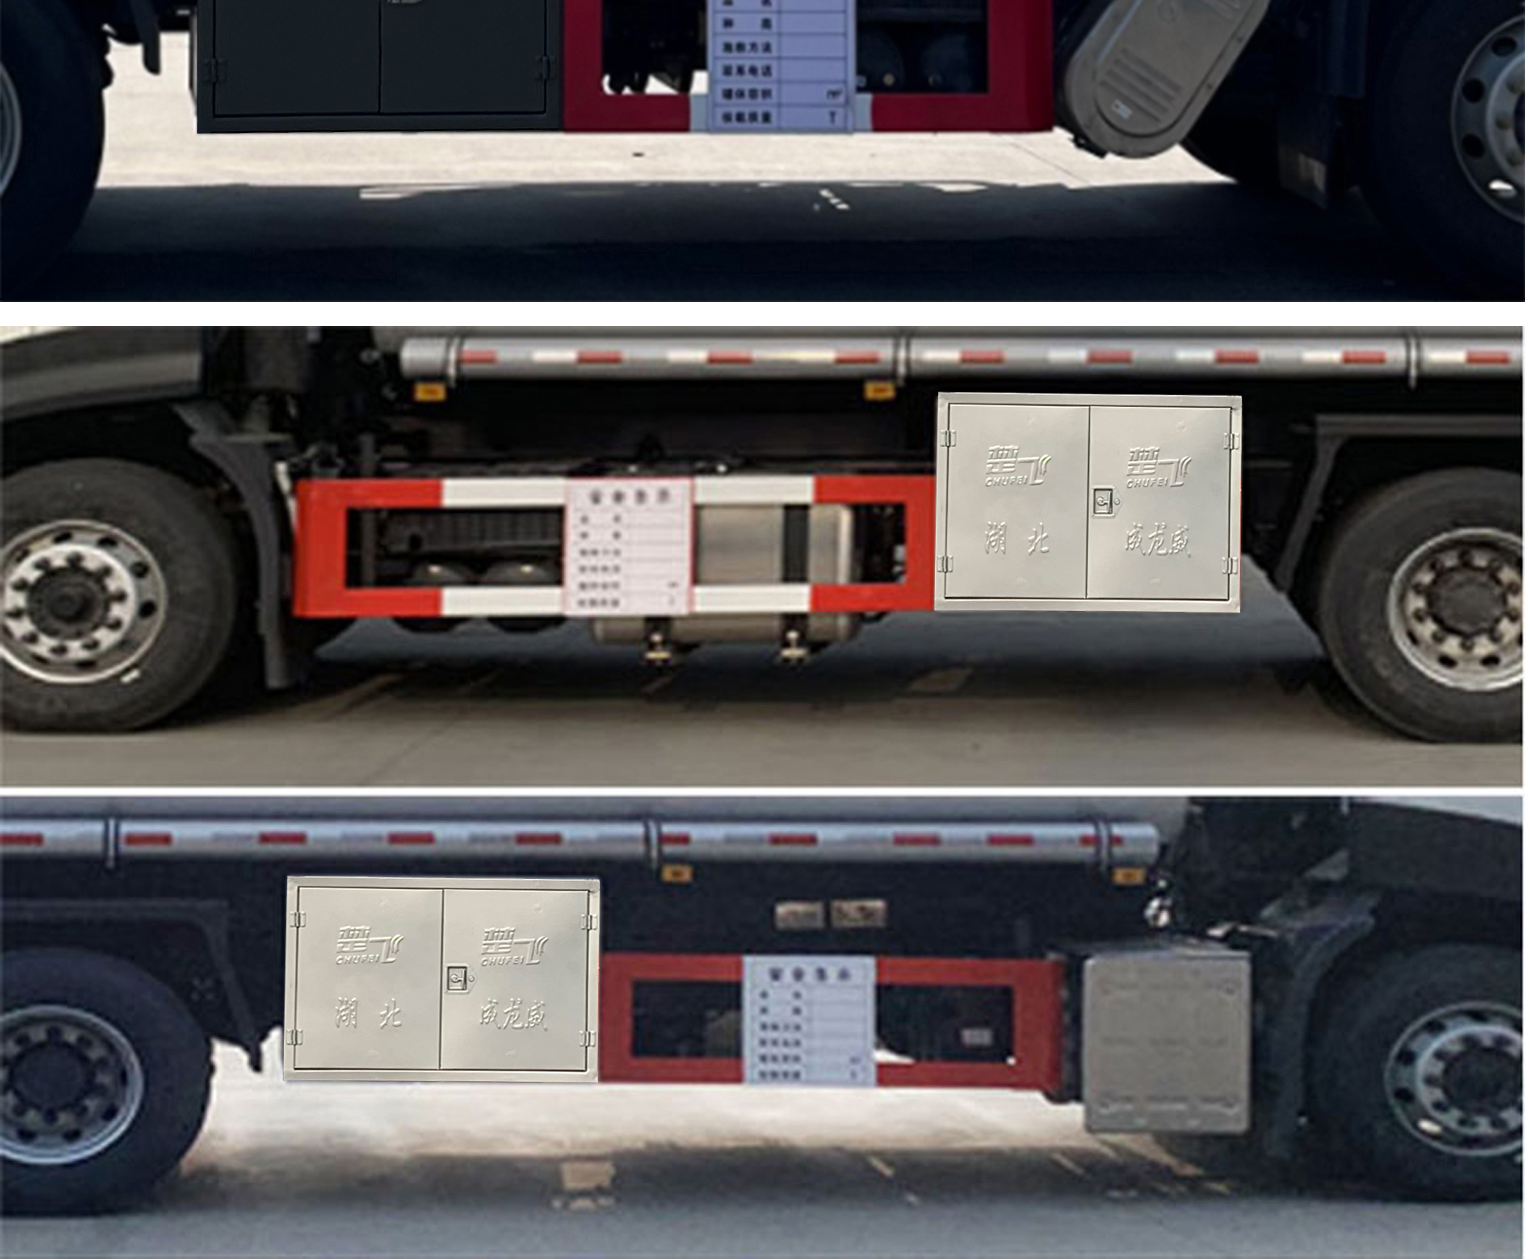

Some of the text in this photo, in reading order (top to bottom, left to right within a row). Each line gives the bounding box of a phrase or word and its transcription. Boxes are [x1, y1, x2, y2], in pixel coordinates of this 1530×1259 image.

[985, 475, 1028, 488] CHUFEI
[1126, 477, 1168, 489] CHUFEI
[985, 521, 1050, 555] 湖北
[335, 953, 380, 965] CHUFEI
[480, 955, 525, 967] CHUFEI
[335, 997, 402, 1030] 湖北
